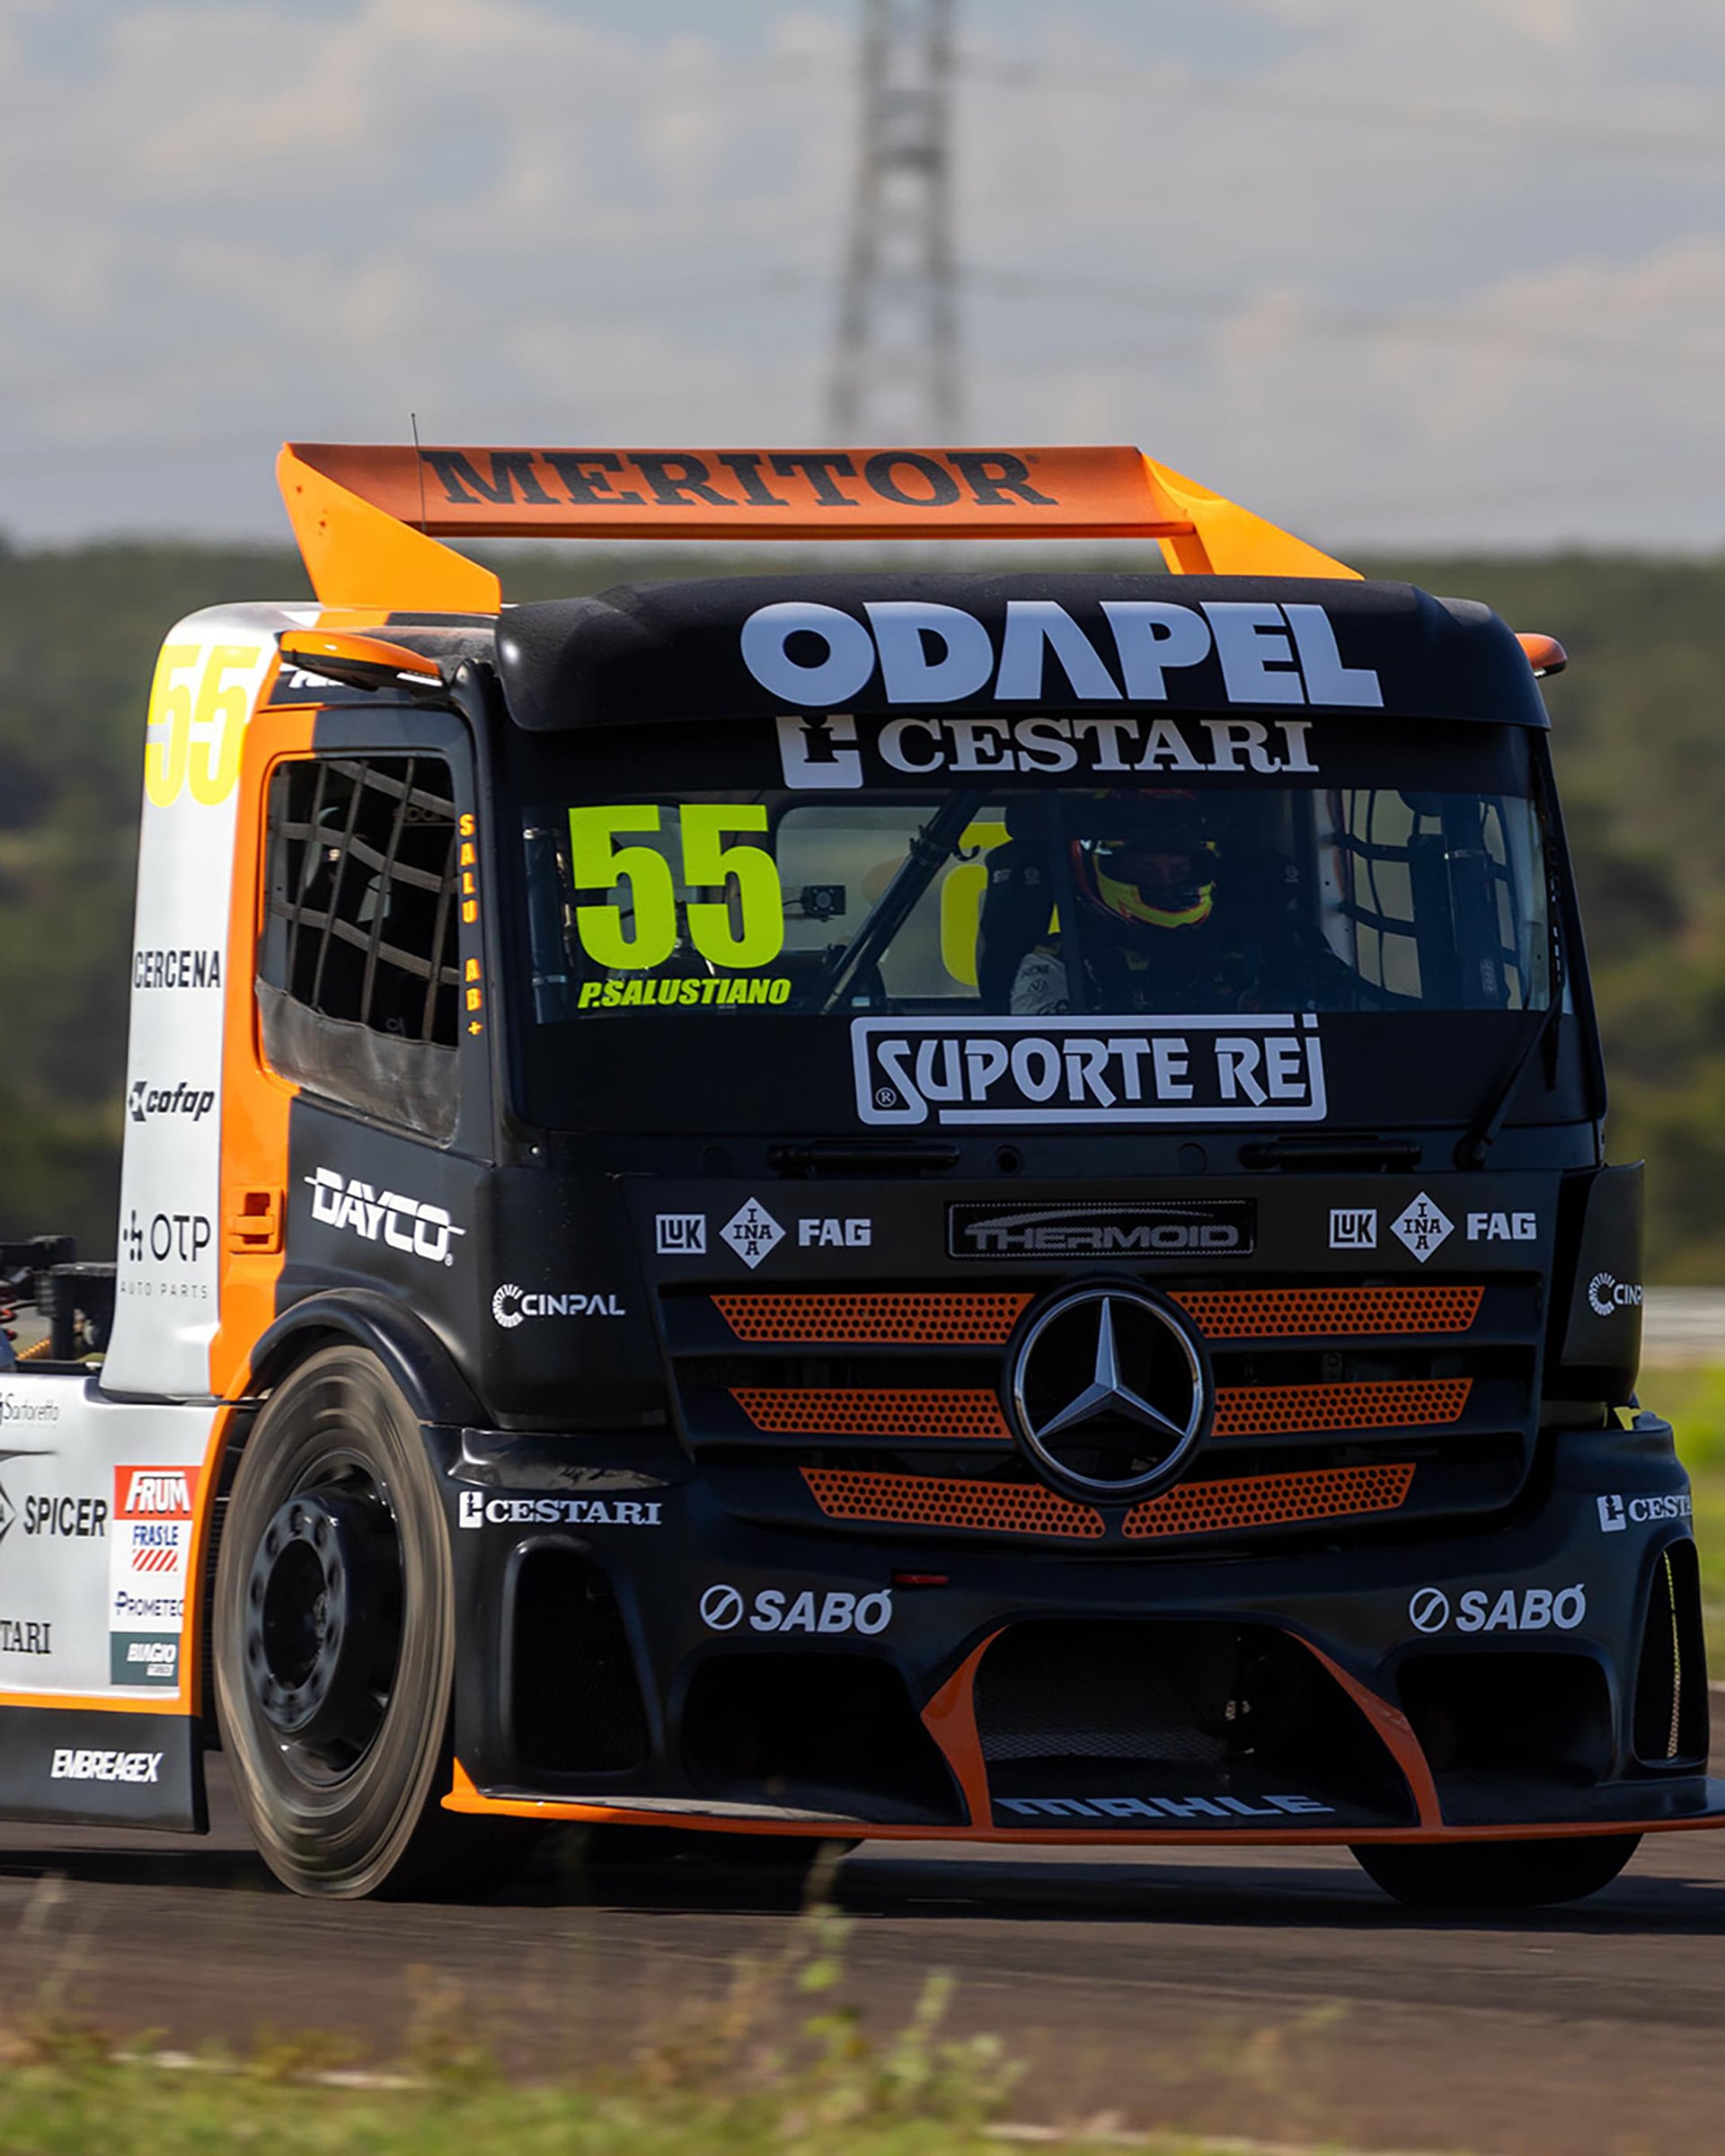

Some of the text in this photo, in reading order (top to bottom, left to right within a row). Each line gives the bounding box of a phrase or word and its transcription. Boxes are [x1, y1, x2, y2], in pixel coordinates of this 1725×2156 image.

[422, 451, 1059, 506] MERITOR
[740, 600, 1385, 706] ODAPEL
[144, 644, 261, 807] 55
[878, 719, 1320, 773] CESTARI
[569, 804, 784, 970] 55
[134, 949, 221, 989] CERCENA
[578, 977, 792, 1008] P.SALUSTIANO
[876, 1037, 1194, 1124] SUPORTE
[146, 1082, 215, 1121] cofap
[305, 1167, 465, 1262] DAYCO
[799, 1219, 871, 1246] FAG
[1466, 1213, 1536, 1240] FAG
[150, 1214, 211, 1261] OTP
[964, 1225, 1239, 1250] THERMOID
[161, 1283, 208, 1299] PARTS
[521, 1294, 626, 1316] CINPAL
[125, 1471, 190, 1513] FRUM
[485, 1499, 663, 1525] CESTARI
[23, 1495, 108, 1536] SPICER
[992, 1795, 1337, 1817] MAHLE
